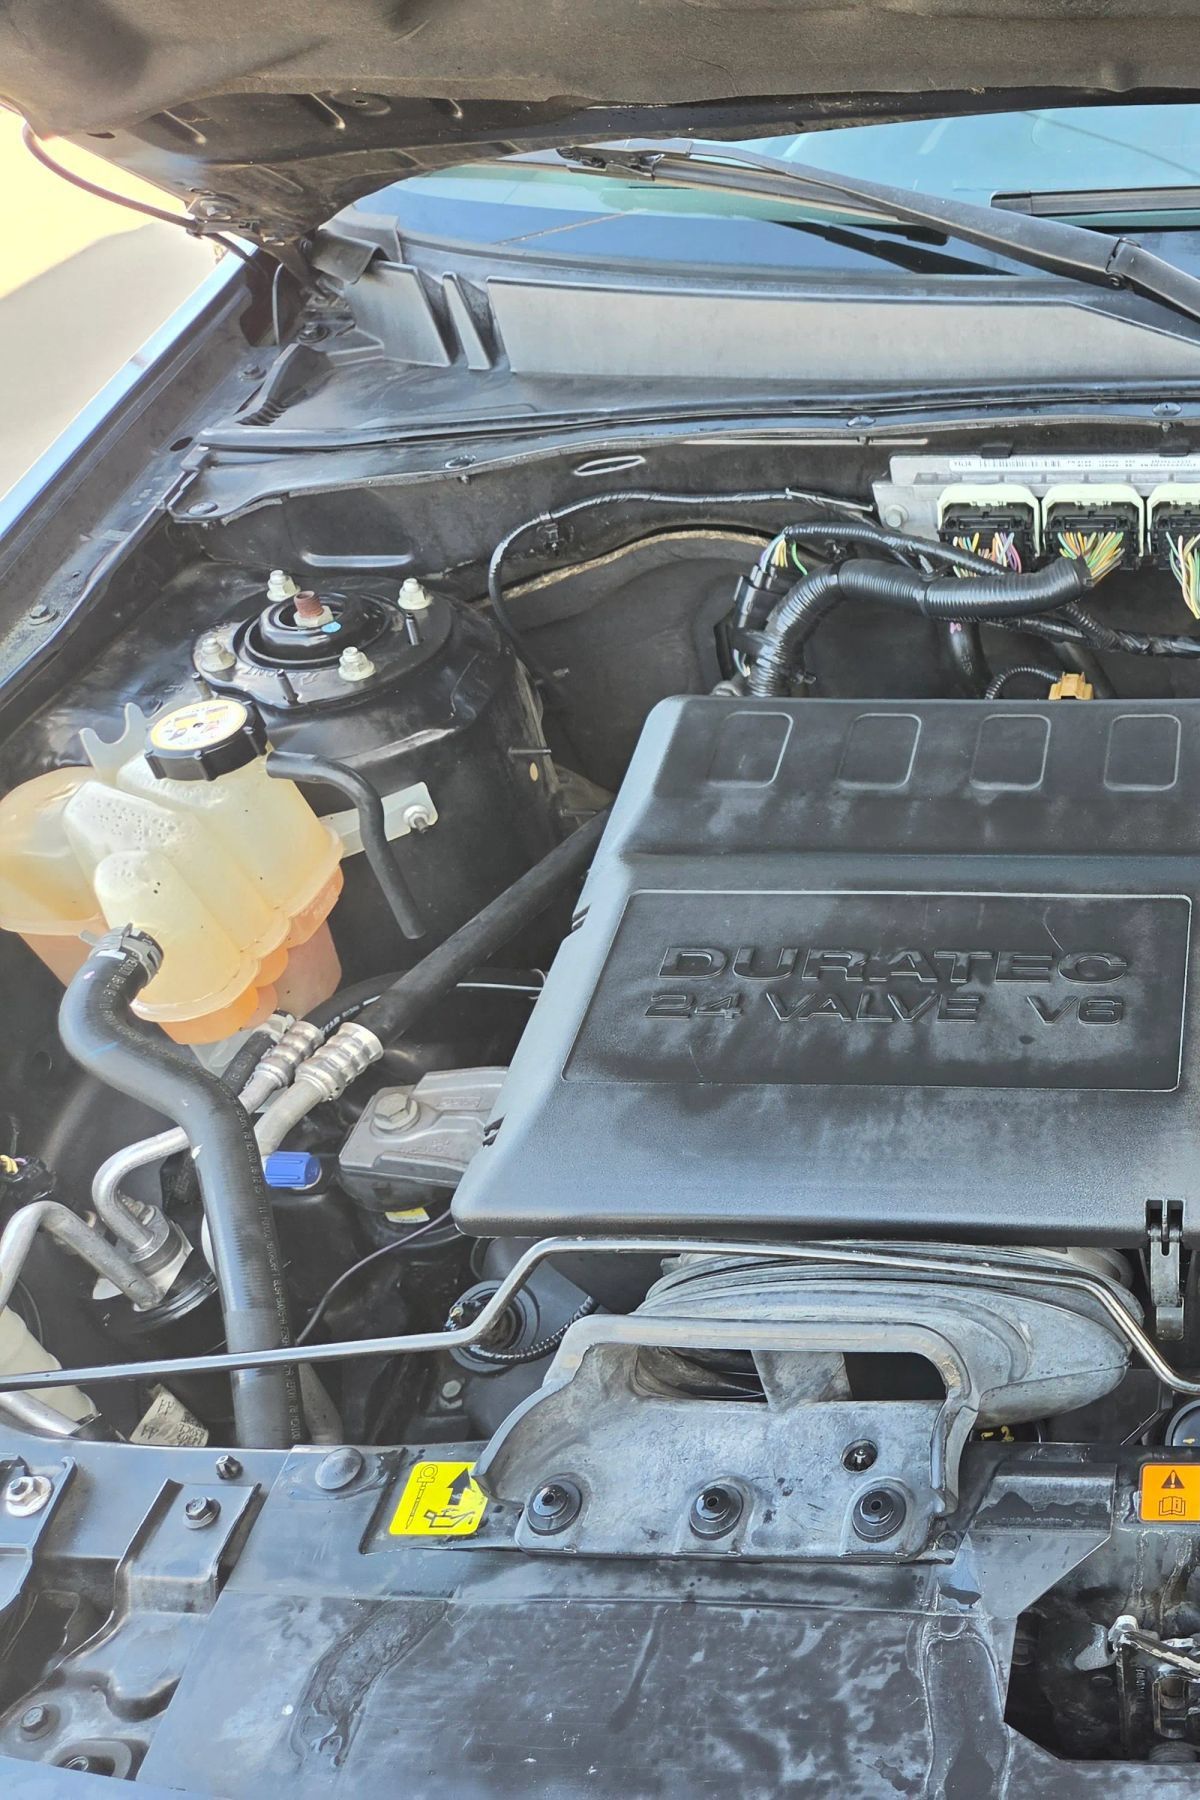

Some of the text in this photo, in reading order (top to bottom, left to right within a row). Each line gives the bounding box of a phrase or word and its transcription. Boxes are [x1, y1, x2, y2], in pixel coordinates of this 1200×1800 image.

[657, 946, 1128, 985] DURATEC
[644, 991, 1125, 1026] 24 VALVE V6
